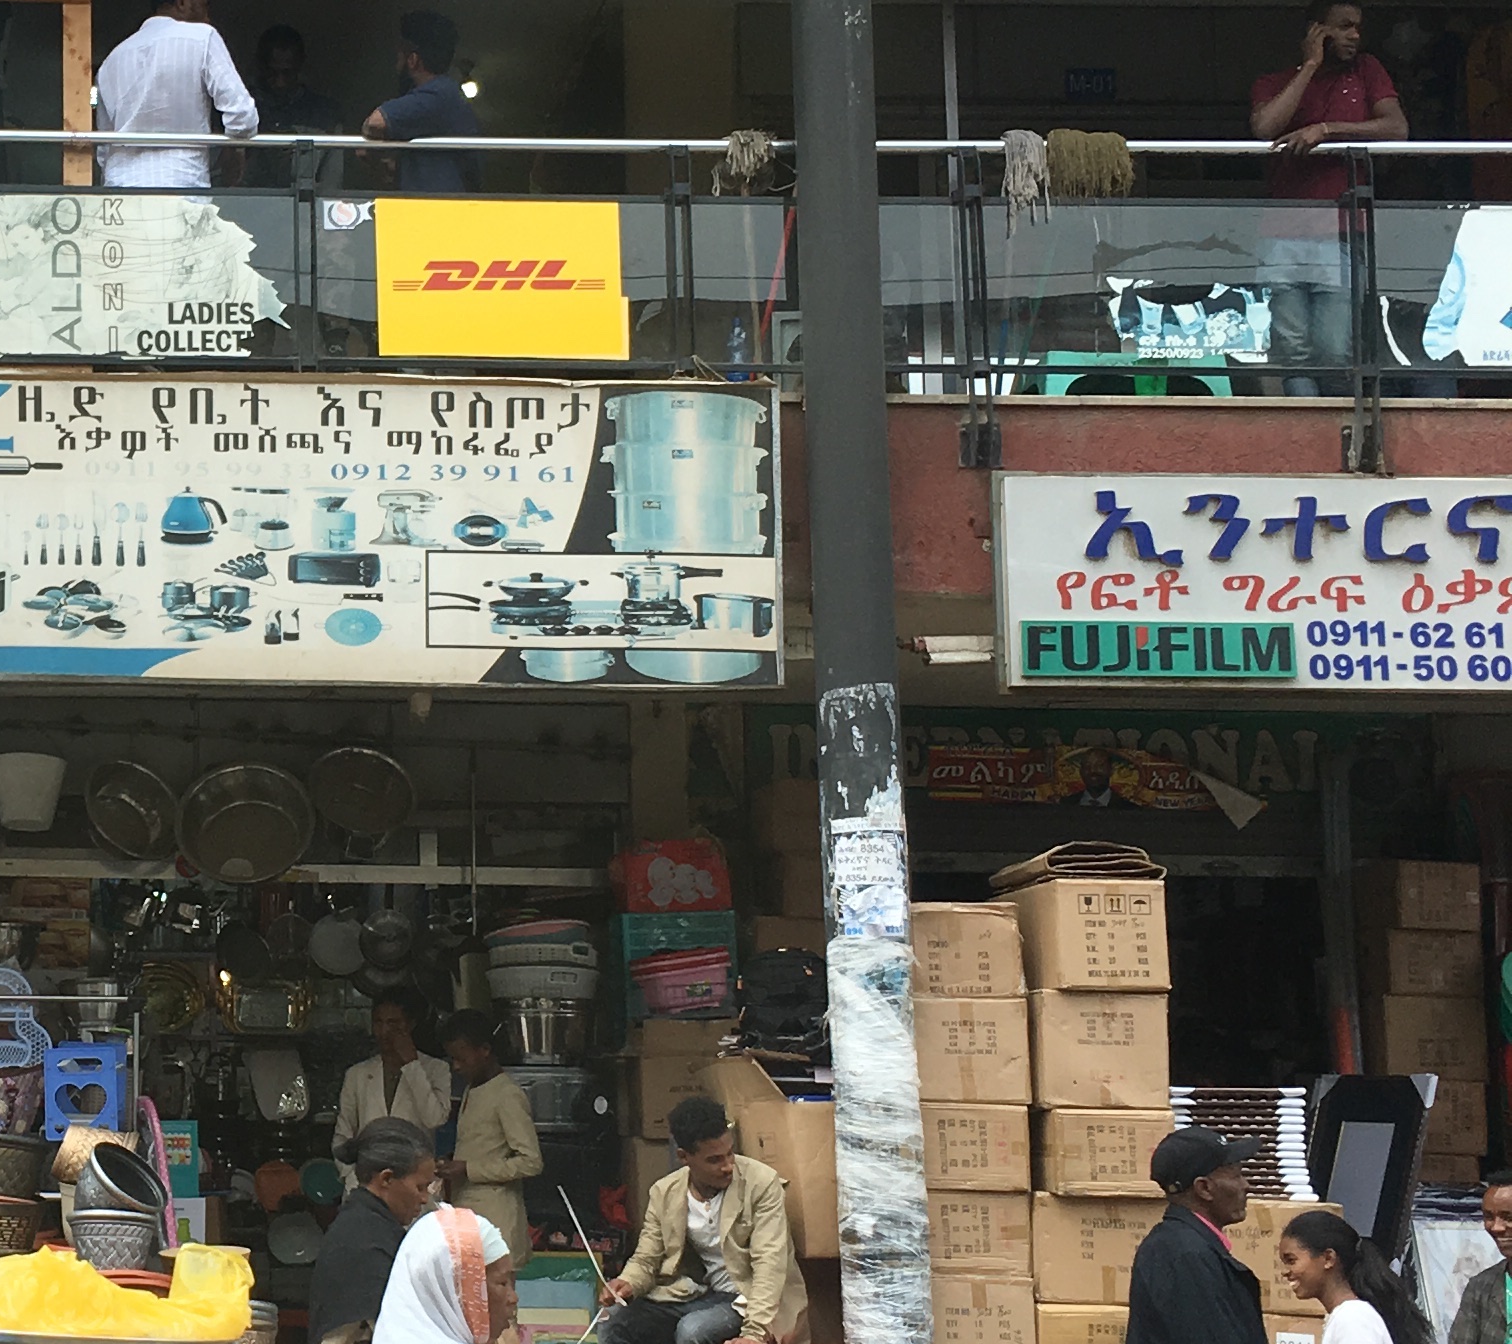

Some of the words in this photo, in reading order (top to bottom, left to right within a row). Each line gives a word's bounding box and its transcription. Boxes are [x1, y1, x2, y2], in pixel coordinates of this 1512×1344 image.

[50, 196, 82, 352] ALDO
[421, 260, 578, 291] DHL
[168, 302, 255, 325] LADIES
[317, 386, 383, 428] እና
[331, 464, 411, 481] 0912
[430, 464, 467, 481] 39
[484, 465, 519, 482] 91
[538, 466, 574, 482] 61
[1056, 570, 1190, 611] የፎቶ
[1222, 573, 1366, 613] ግራፍ
[1027, 625, 1292, 672] FUJIFILM
[1465, 621, 1504, 649] 61
